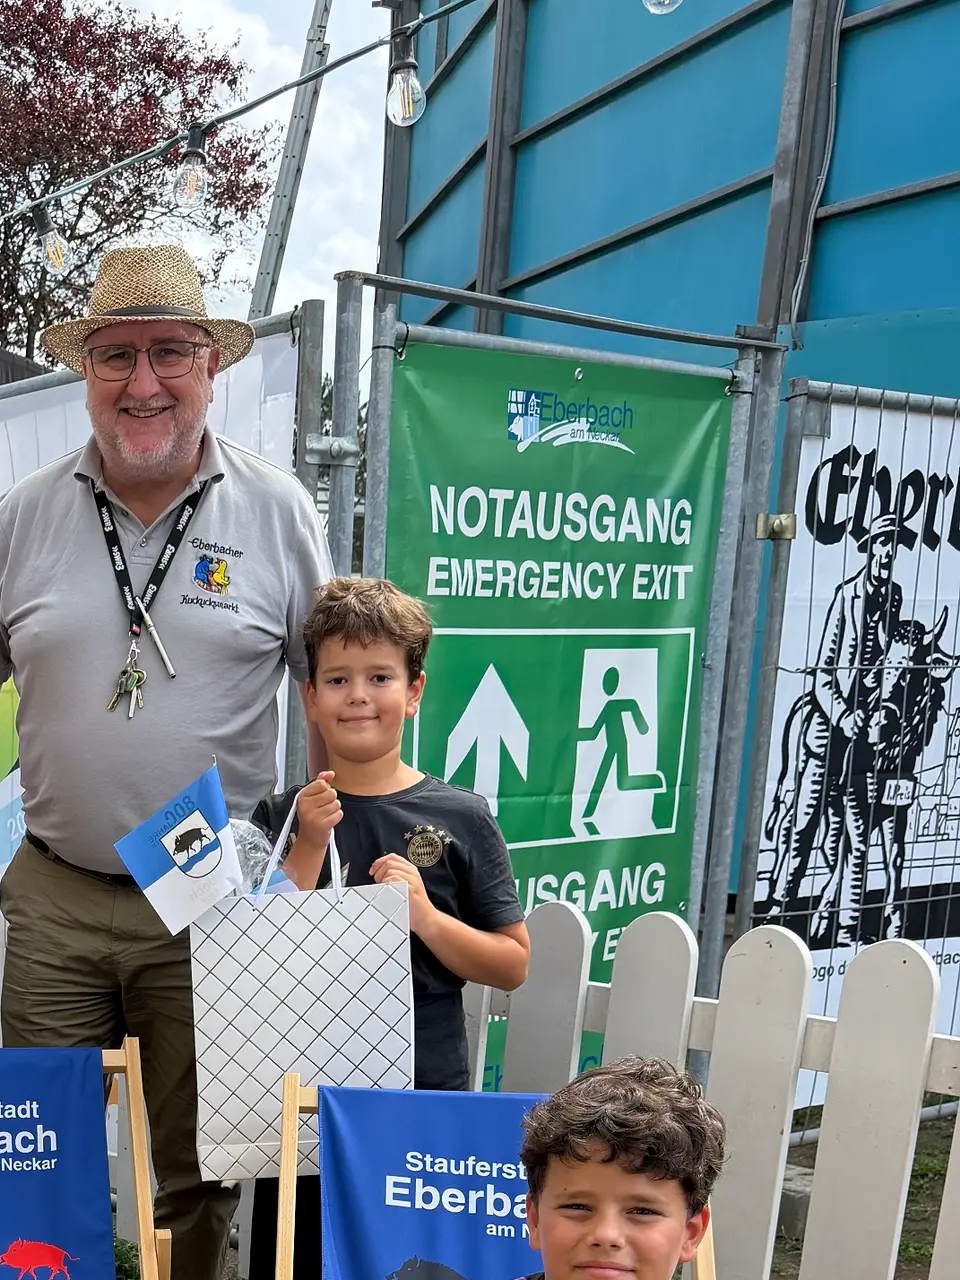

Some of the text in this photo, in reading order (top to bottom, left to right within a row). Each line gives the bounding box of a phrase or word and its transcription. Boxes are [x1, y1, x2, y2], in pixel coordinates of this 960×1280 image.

[539, 391, 634, 429] Eberbach
[570, 428, 585, 440] am
[429, 484, 692, 546] NOTAUSGANG
[188, 537, 244, 558] Eberbacher
[427, 556, 694, 600] EMERGENCY EXIT
[1, 1157, 58, 1172] Neckar
[486, 1223, 515, 1238] am
